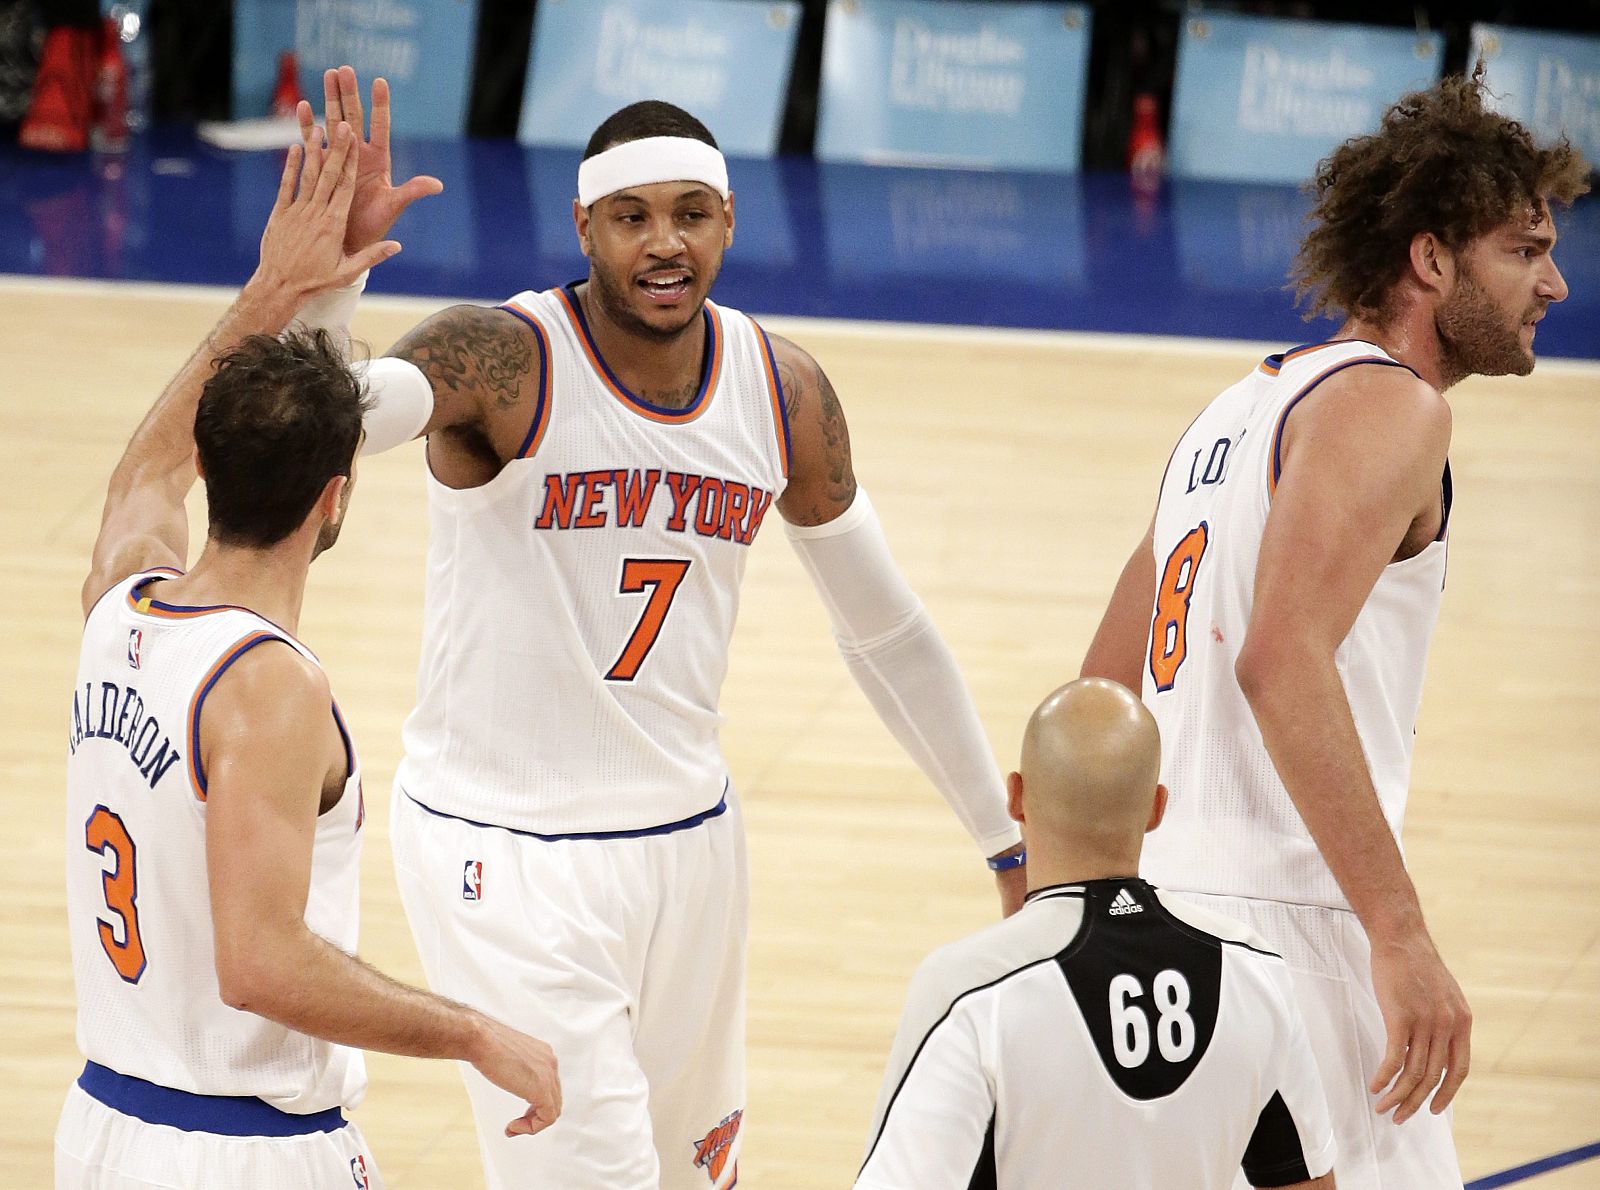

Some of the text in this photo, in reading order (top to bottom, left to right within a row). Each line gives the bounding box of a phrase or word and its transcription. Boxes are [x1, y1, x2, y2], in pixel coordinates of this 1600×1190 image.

[534, 468, 772, 546] NEW YORK
[1185, 428, 1246, 495] LO
[603, 558, 692, 681] 7
[1149, 519, 1209, 694] 8
[69, 682, 181, 790] ALDERON
[85, 804, 148, 986] 3
[1109, 903, 1144, 916] adidas
[1108, 968, 1196, 1069] 68
